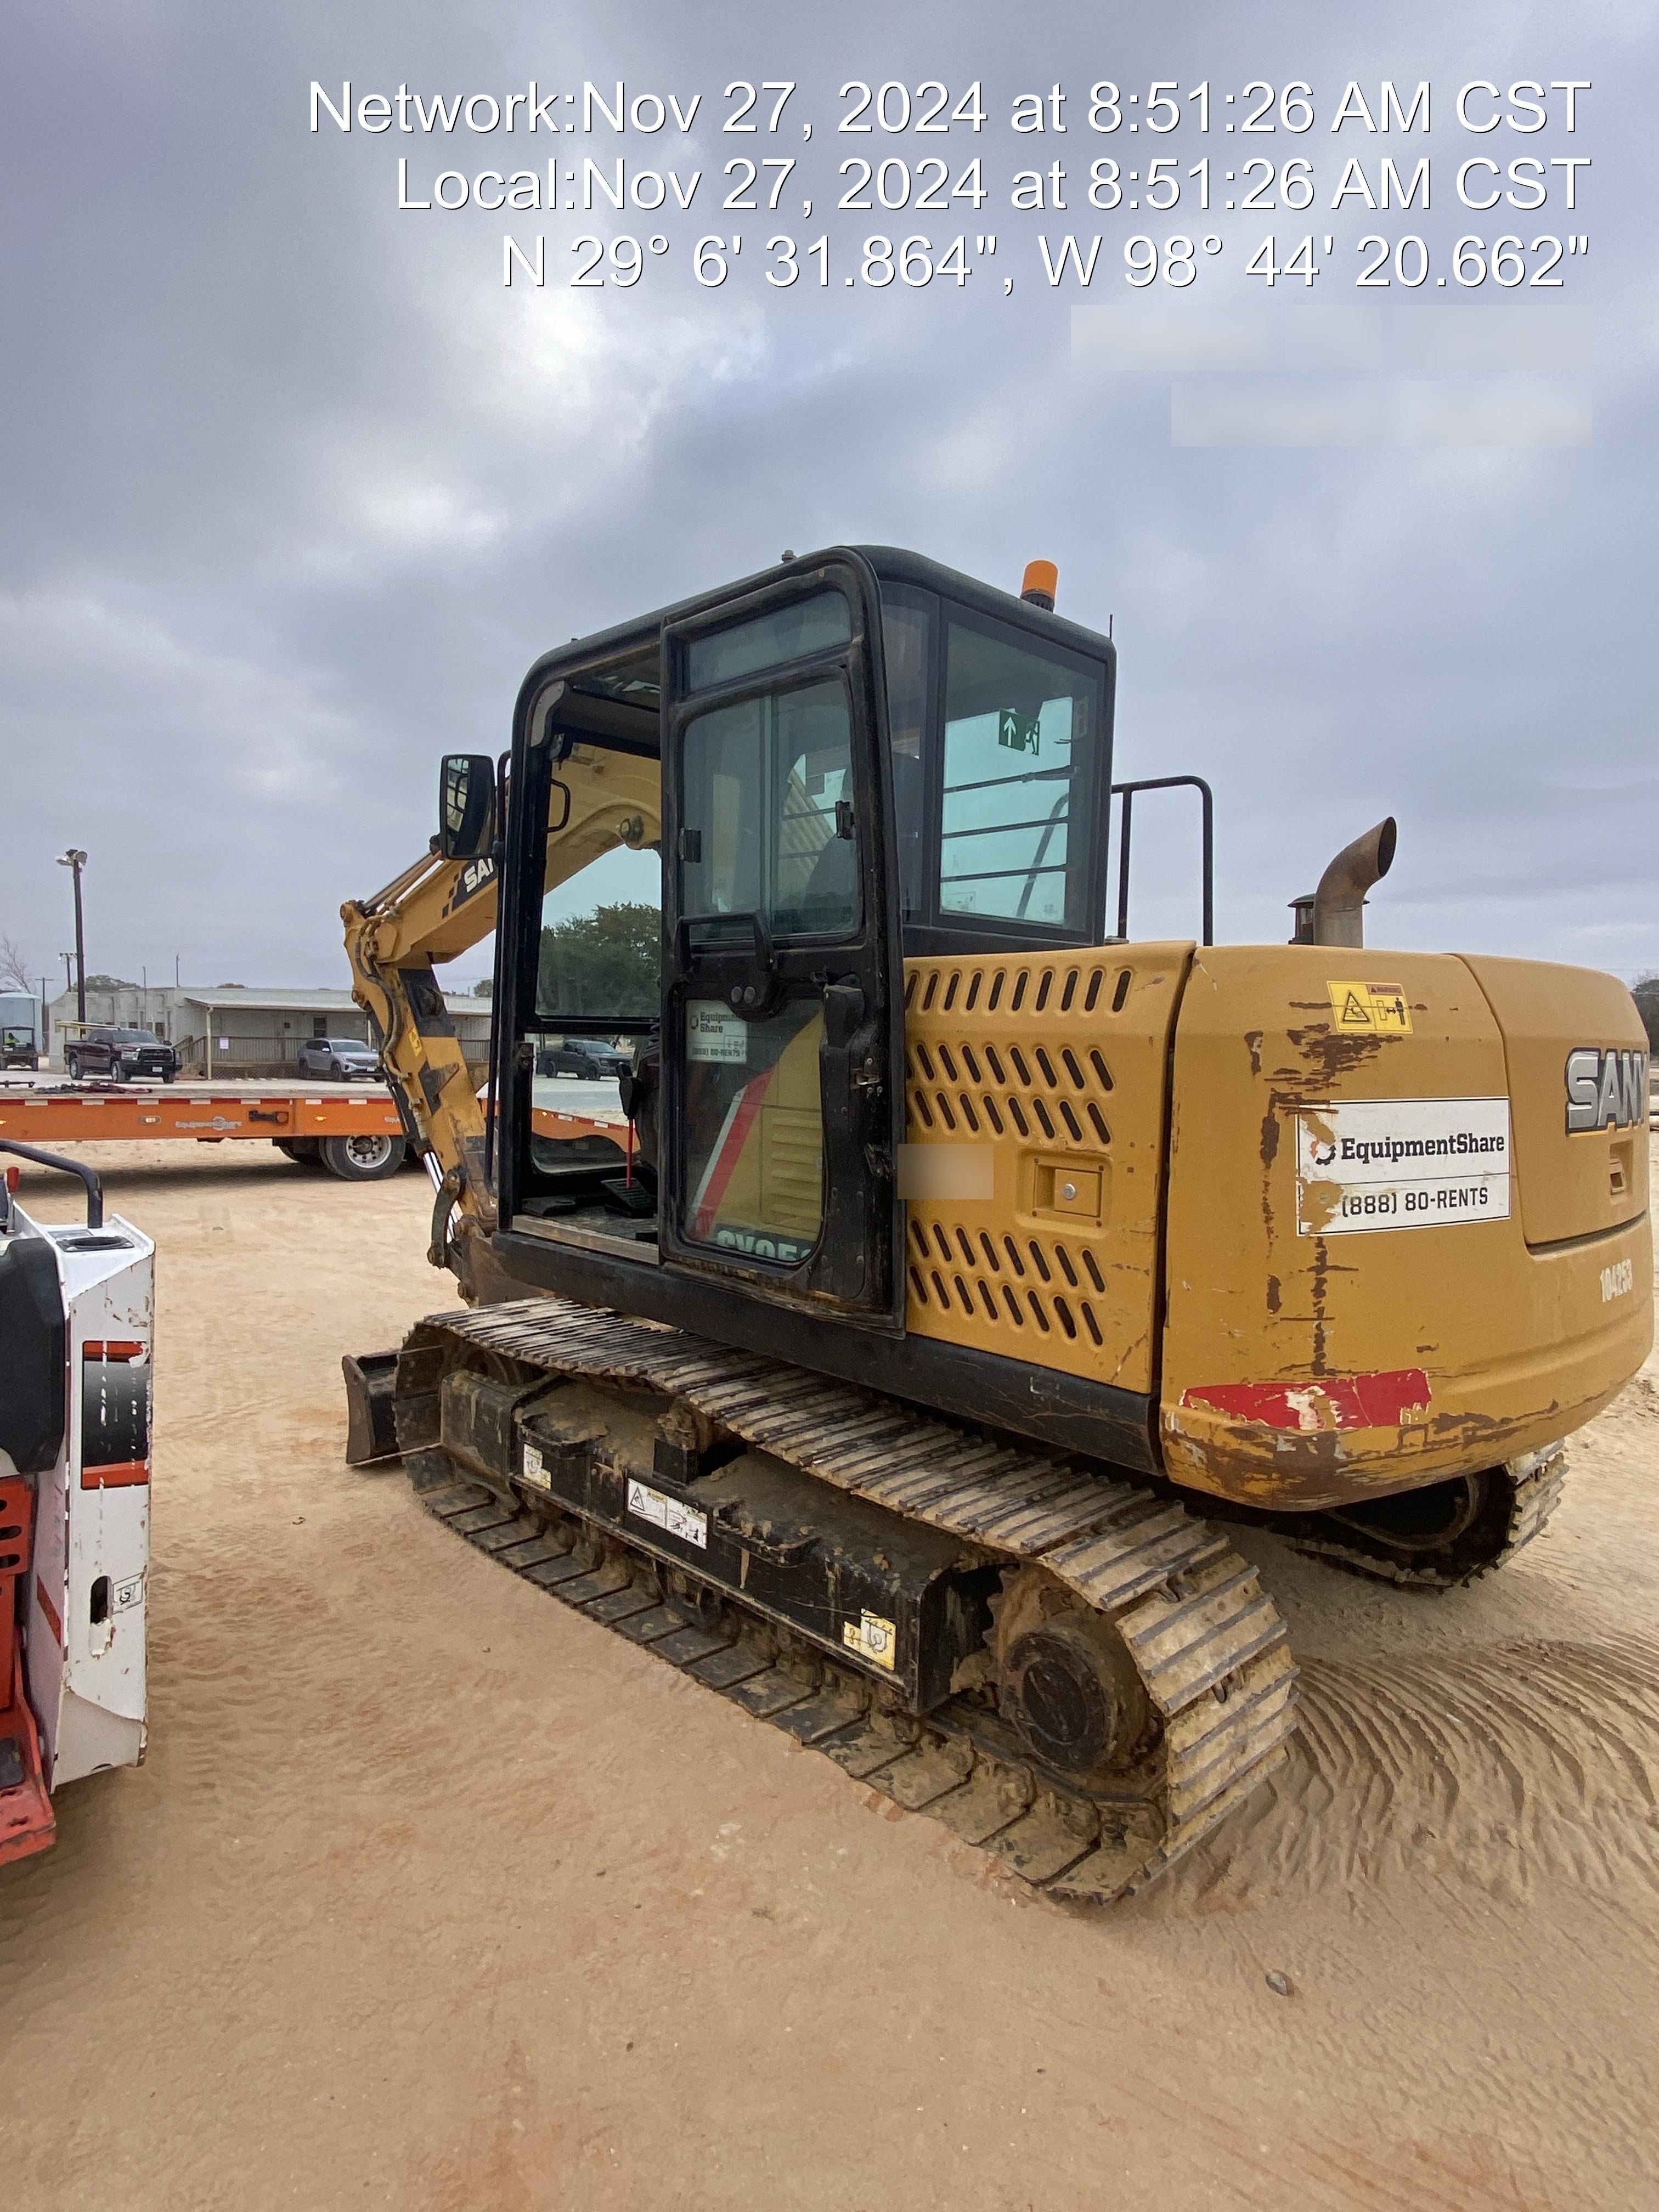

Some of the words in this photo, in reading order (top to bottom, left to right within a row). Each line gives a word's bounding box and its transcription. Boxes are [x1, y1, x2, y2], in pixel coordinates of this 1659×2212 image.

[700, 1023, 723, 1032] Share
[1341, 1133, 1504, 1164] EquipmentShare
[1342, 1193, 1397, 1217] (888)
[1405, 1187, 1488, 1211] 80-RENTS
